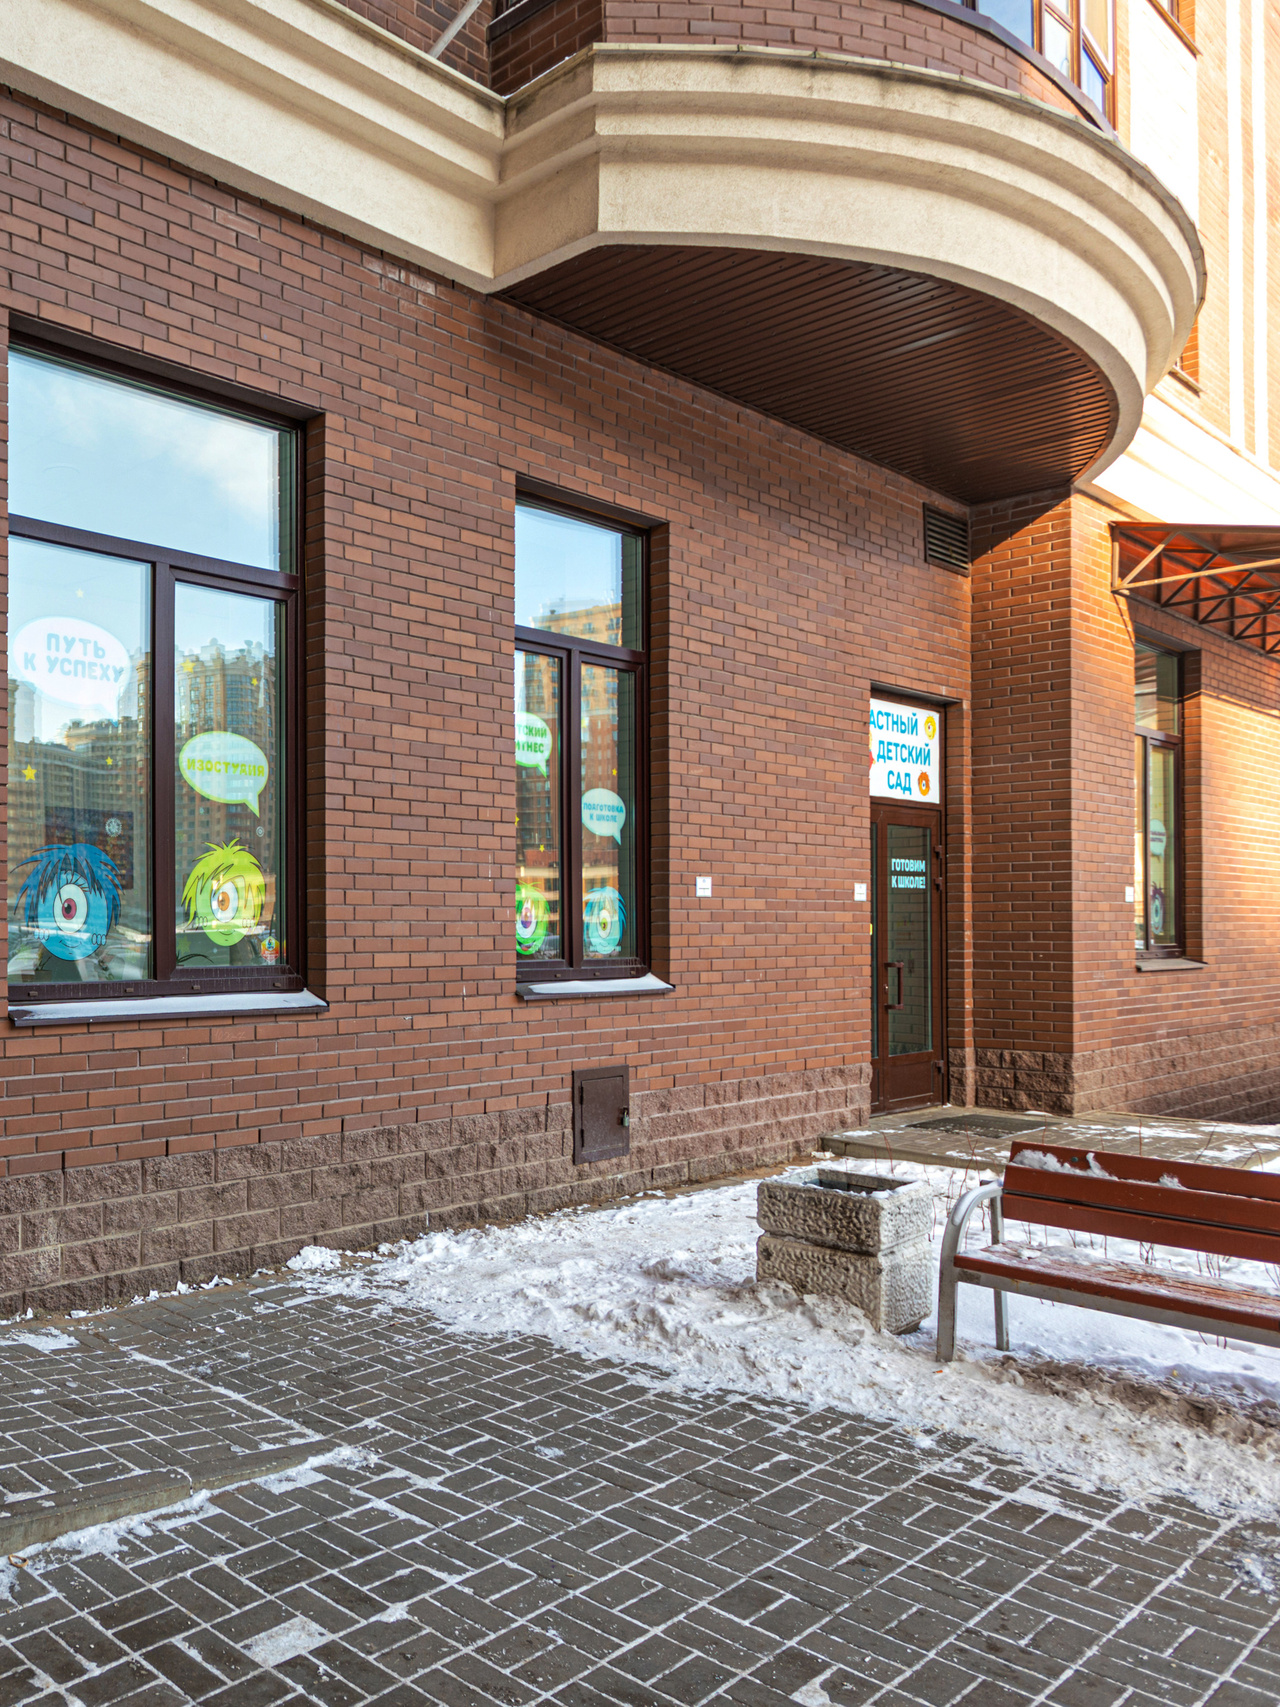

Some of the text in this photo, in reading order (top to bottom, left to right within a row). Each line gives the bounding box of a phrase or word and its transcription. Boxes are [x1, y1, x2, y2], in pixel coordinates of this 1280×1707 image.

[46, 632, 106, 660] ПУТЬ
[23, 652, 124, 684] К УСПЕХУ
[516, 724, 547, 739] ТСКИЙ
[870, 709, 918, 736] АСТНЫЙ
[877, 739, 931, 767] ДЕТСКИЙ
[186, 758, 266, 778] ИЗОСТУДИЯ
[887, 769, 912, 796] САД
[583, 802, 624, 814] ПОДГОТОВКА
[589, 813, 618, 823] К ШКОЛЕ
[891, 858, 926, 872] ГОТОВИМ
[891, 875, 926, 889] К ШКОЛЕ!
